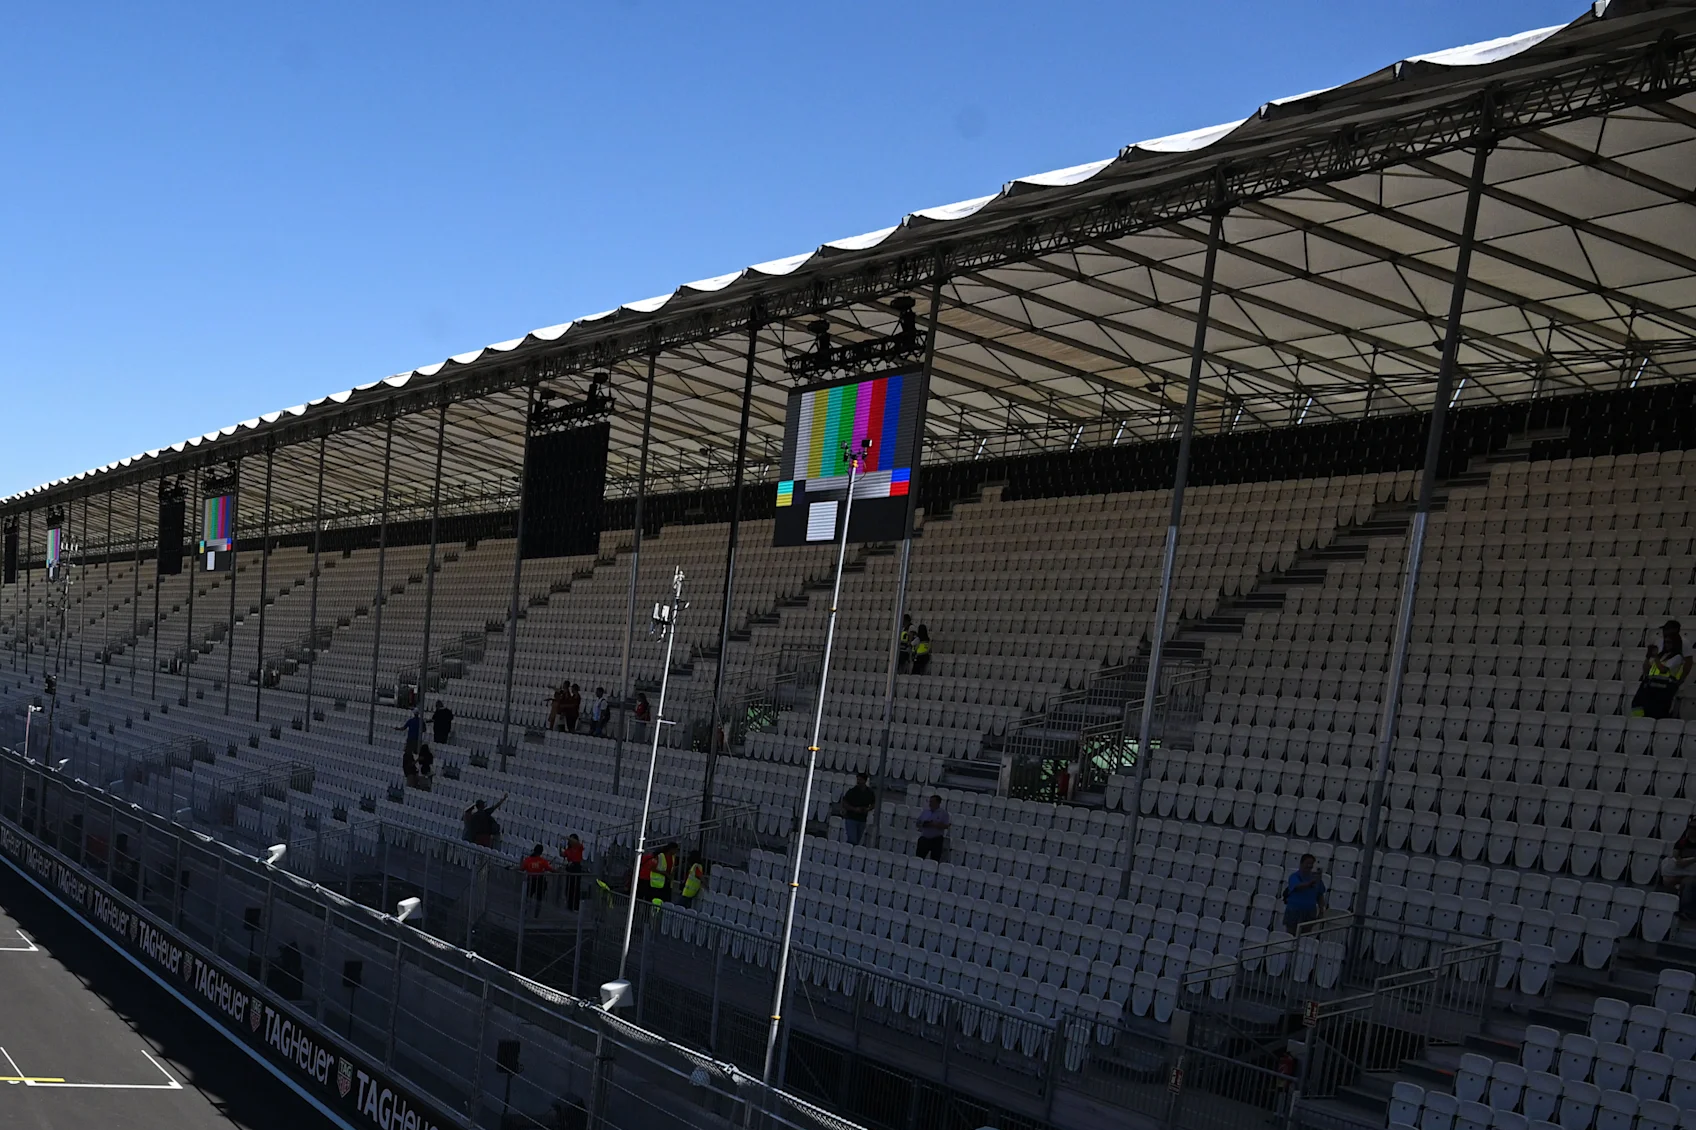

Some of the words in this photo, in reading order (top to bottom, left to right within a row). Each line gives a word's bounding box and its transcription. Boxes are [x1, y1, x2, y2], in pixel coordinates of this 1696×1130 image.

[57, 864, 87, 905] TAGHeuer
[94, 890, 130, 937] TAGHeuer
[139, 920, 182, 974] TAGHeuer
[195, 958, 249, 1023] TAGHeuer
[265, 1006, 334, 1085] TAGHeuer
[339, 1059, 353, 1077] TAG
